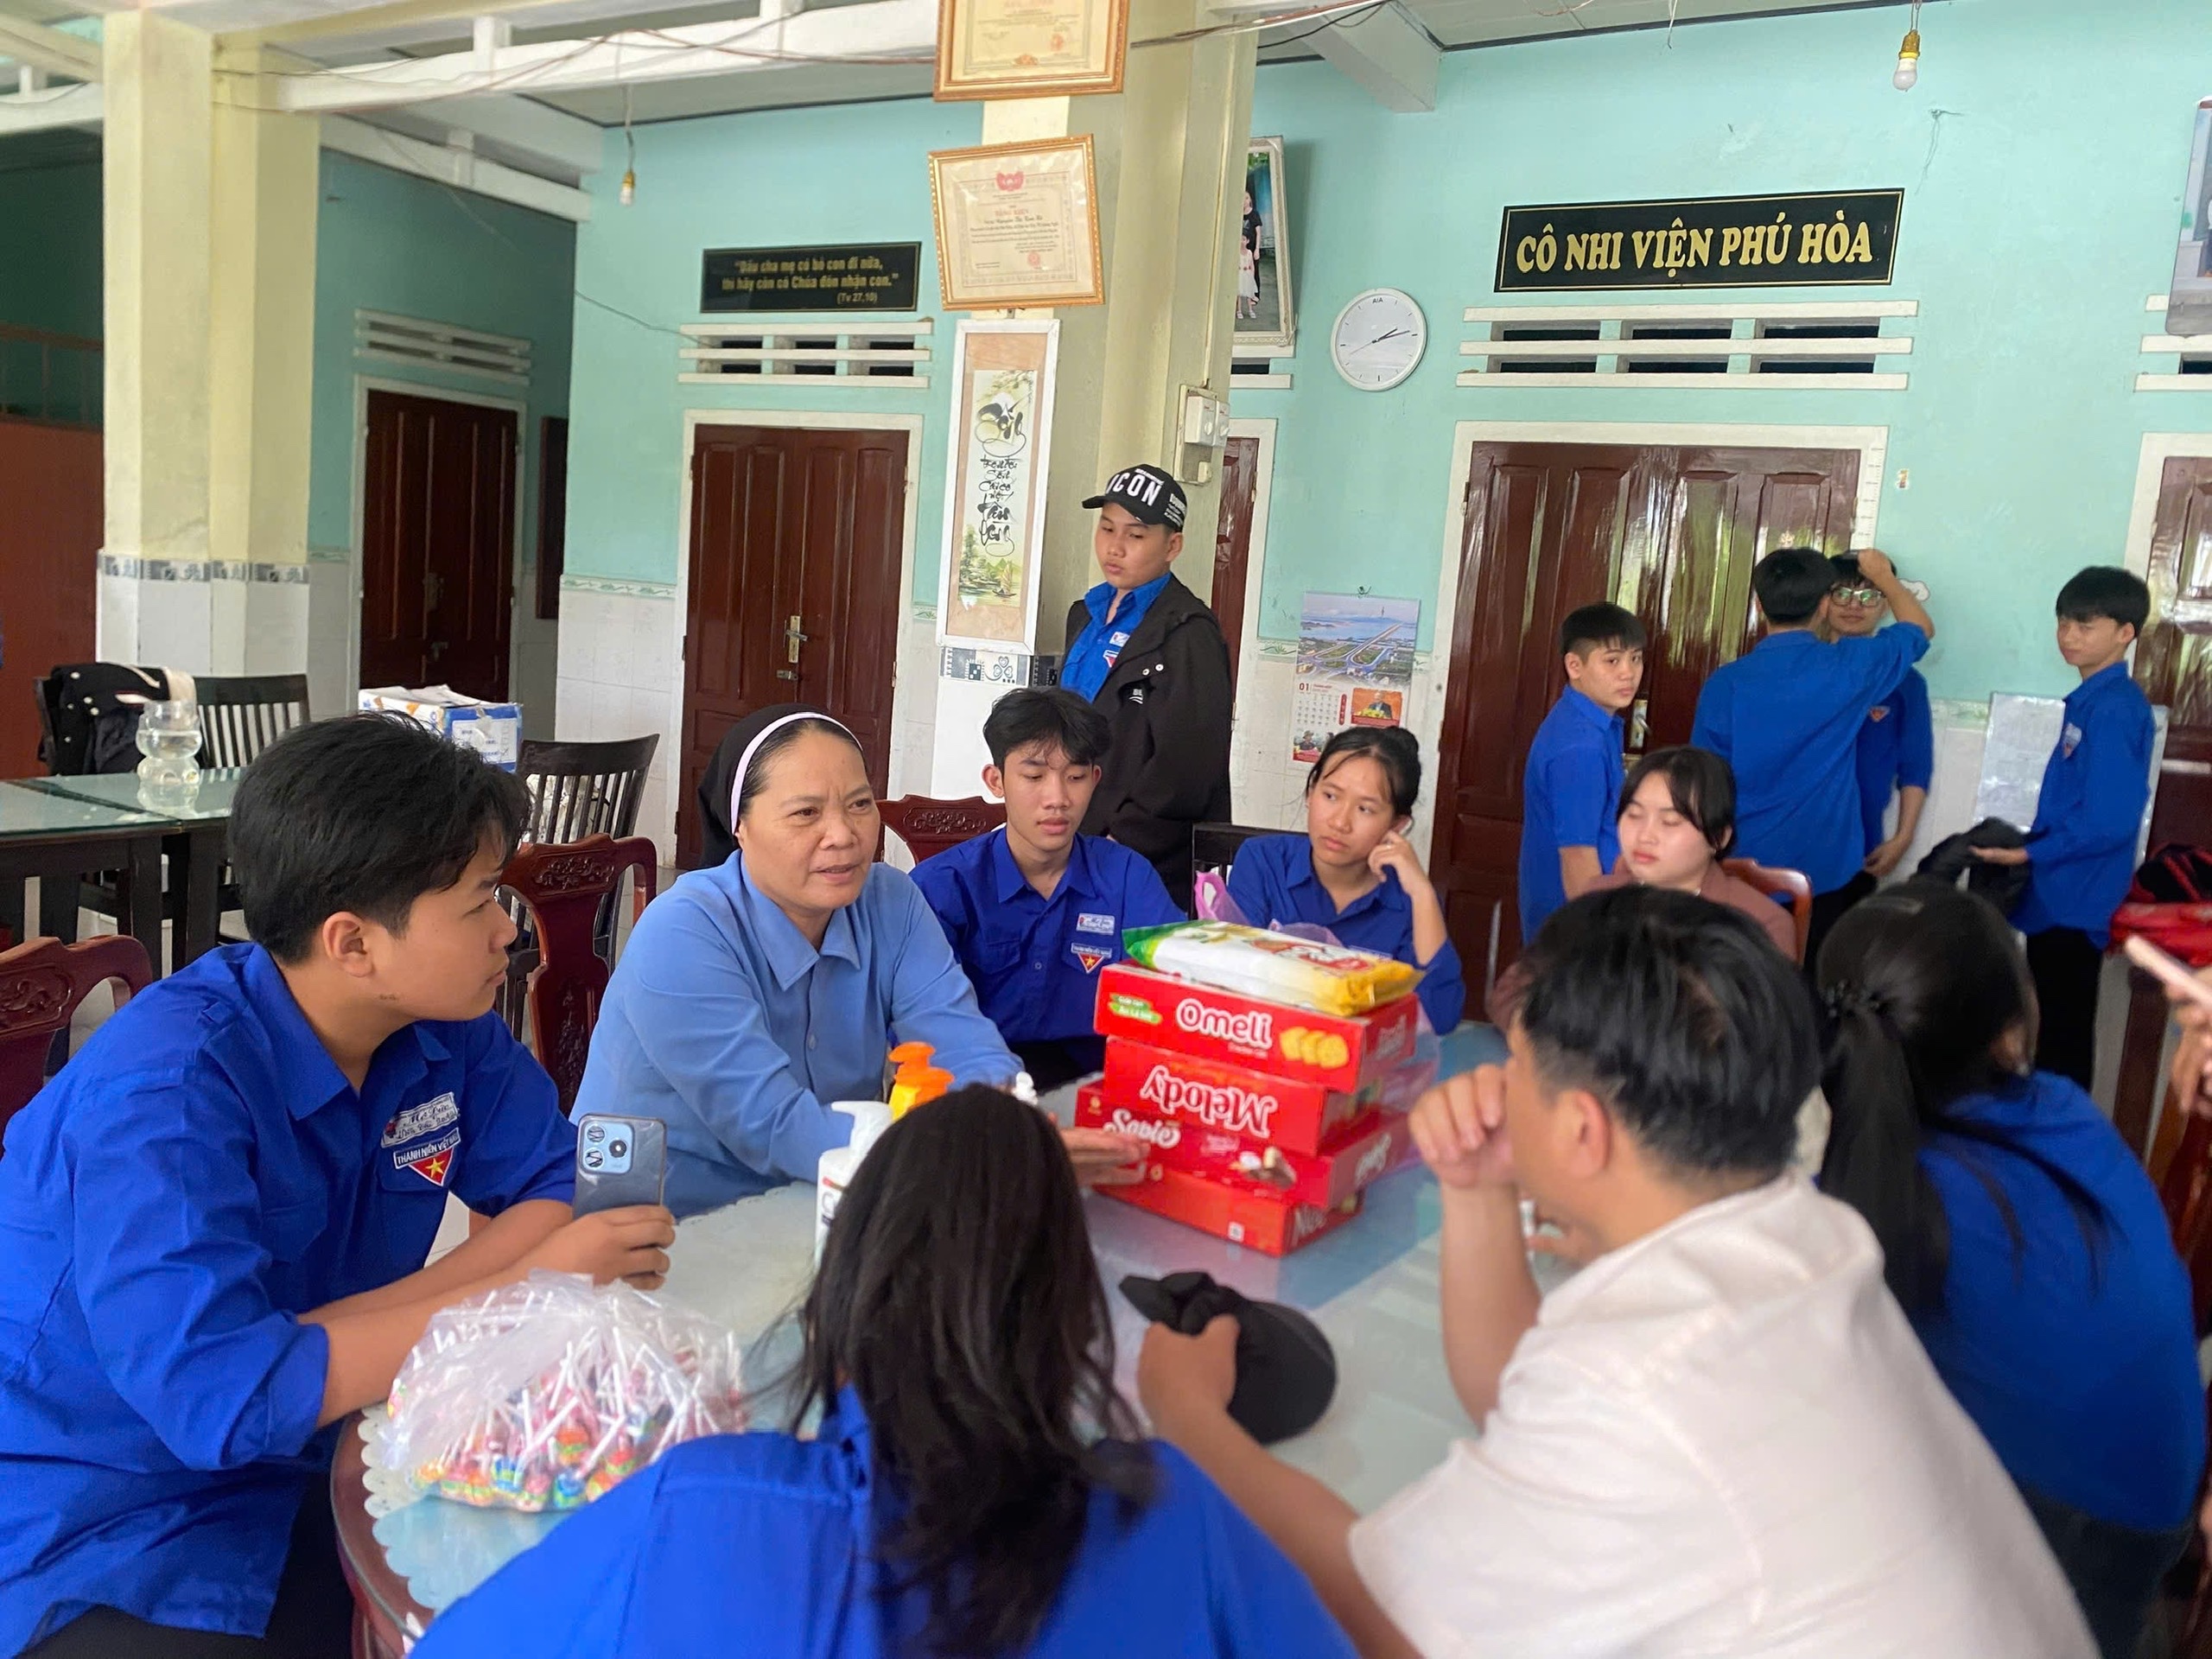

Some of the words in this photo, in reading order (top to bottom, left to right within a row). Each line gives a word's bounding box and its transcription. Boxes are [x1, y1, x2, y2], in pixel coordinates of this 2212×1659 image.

[1516, 223, 1557, 273] CÔ
[1564, 232, 1624, 271] NHI
[1631, 217, 1713, 277] VIỆN
[1719, 212, 1792, 266] PHÚ
[1797, 210, 1872, 264] HÒA
[827, 260, 845, 270] con
[791, 275, 817, 289] Chúa
[841, 275, 866, 289] nhận
[1105, 472, 1162, 506] ICON
[1299, 682, 1309, 691] 01
[1176, 998, 1273, 1050] Omeli
[1140, 1065, 1278, 1139] Melody
[397, 1150, 421, 1165] THANH
